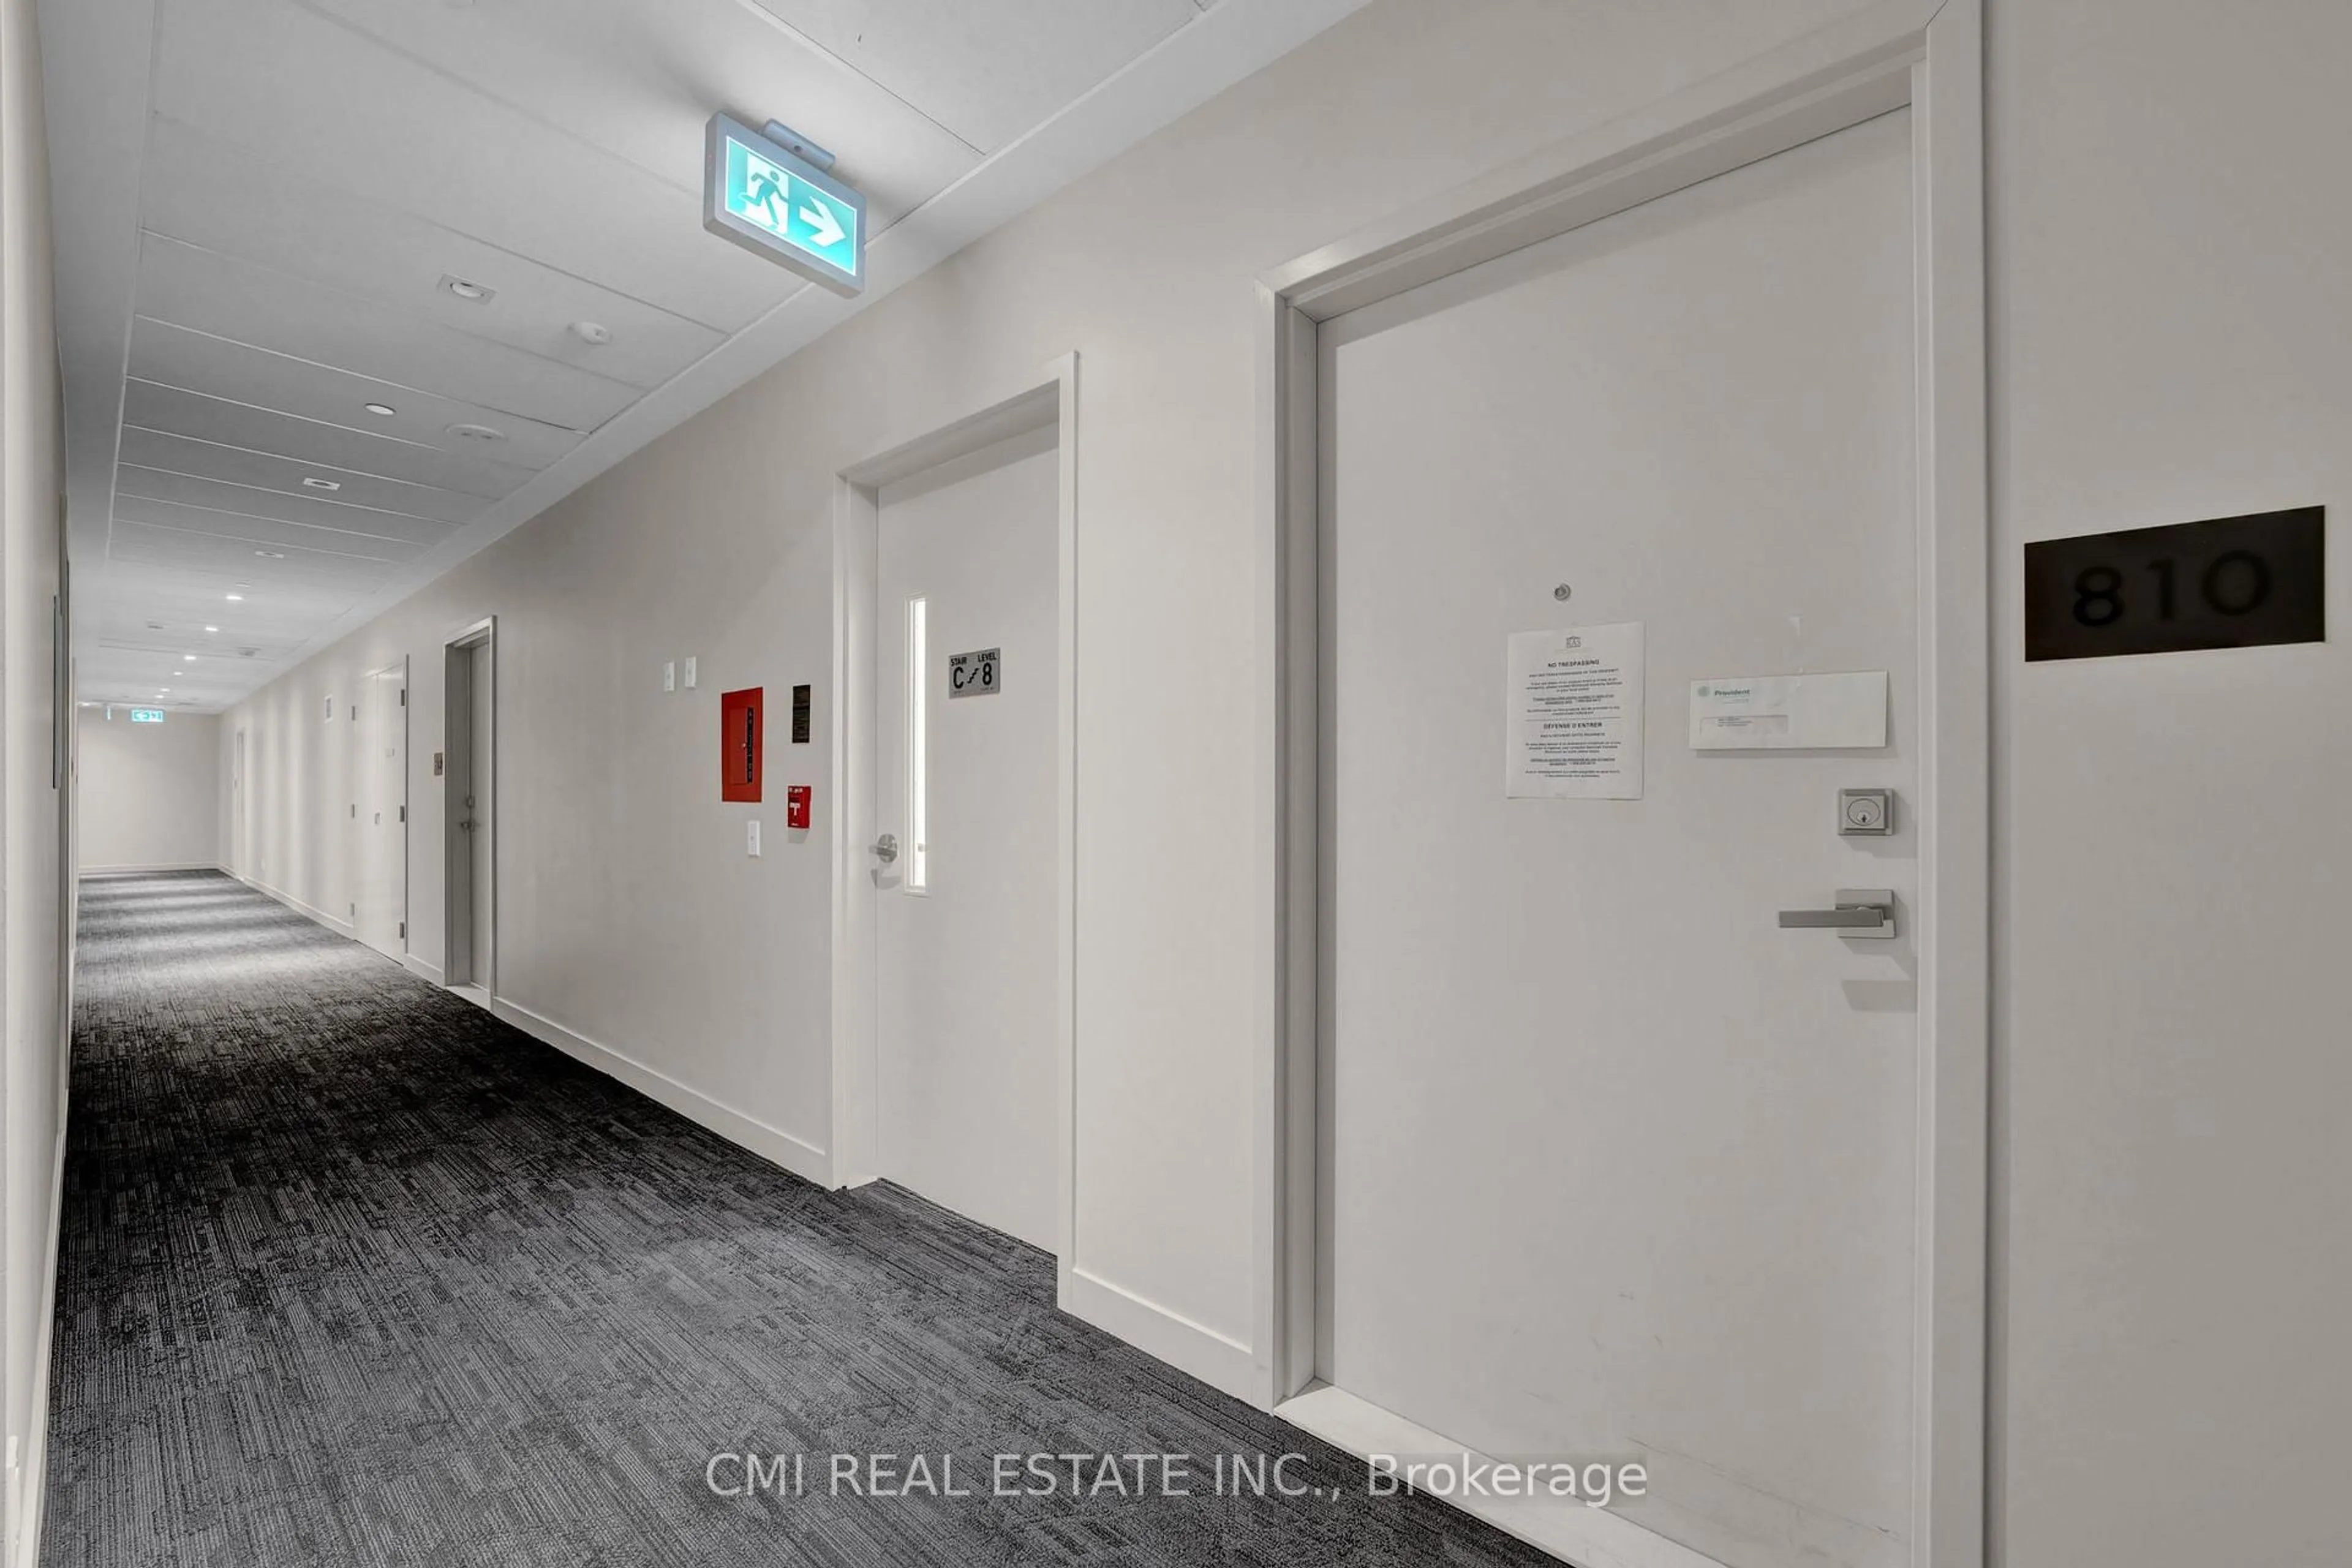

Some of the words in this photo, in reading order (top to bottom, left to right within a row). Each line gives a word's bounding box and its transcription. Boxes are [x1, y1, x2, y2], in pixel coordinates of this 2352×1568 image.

[2072, 550, 2272, 627] 810
[978, 651, 997, 662] LEVEL
[953, 666, 964, 689] C
[982, 662, 992, 685] 8
